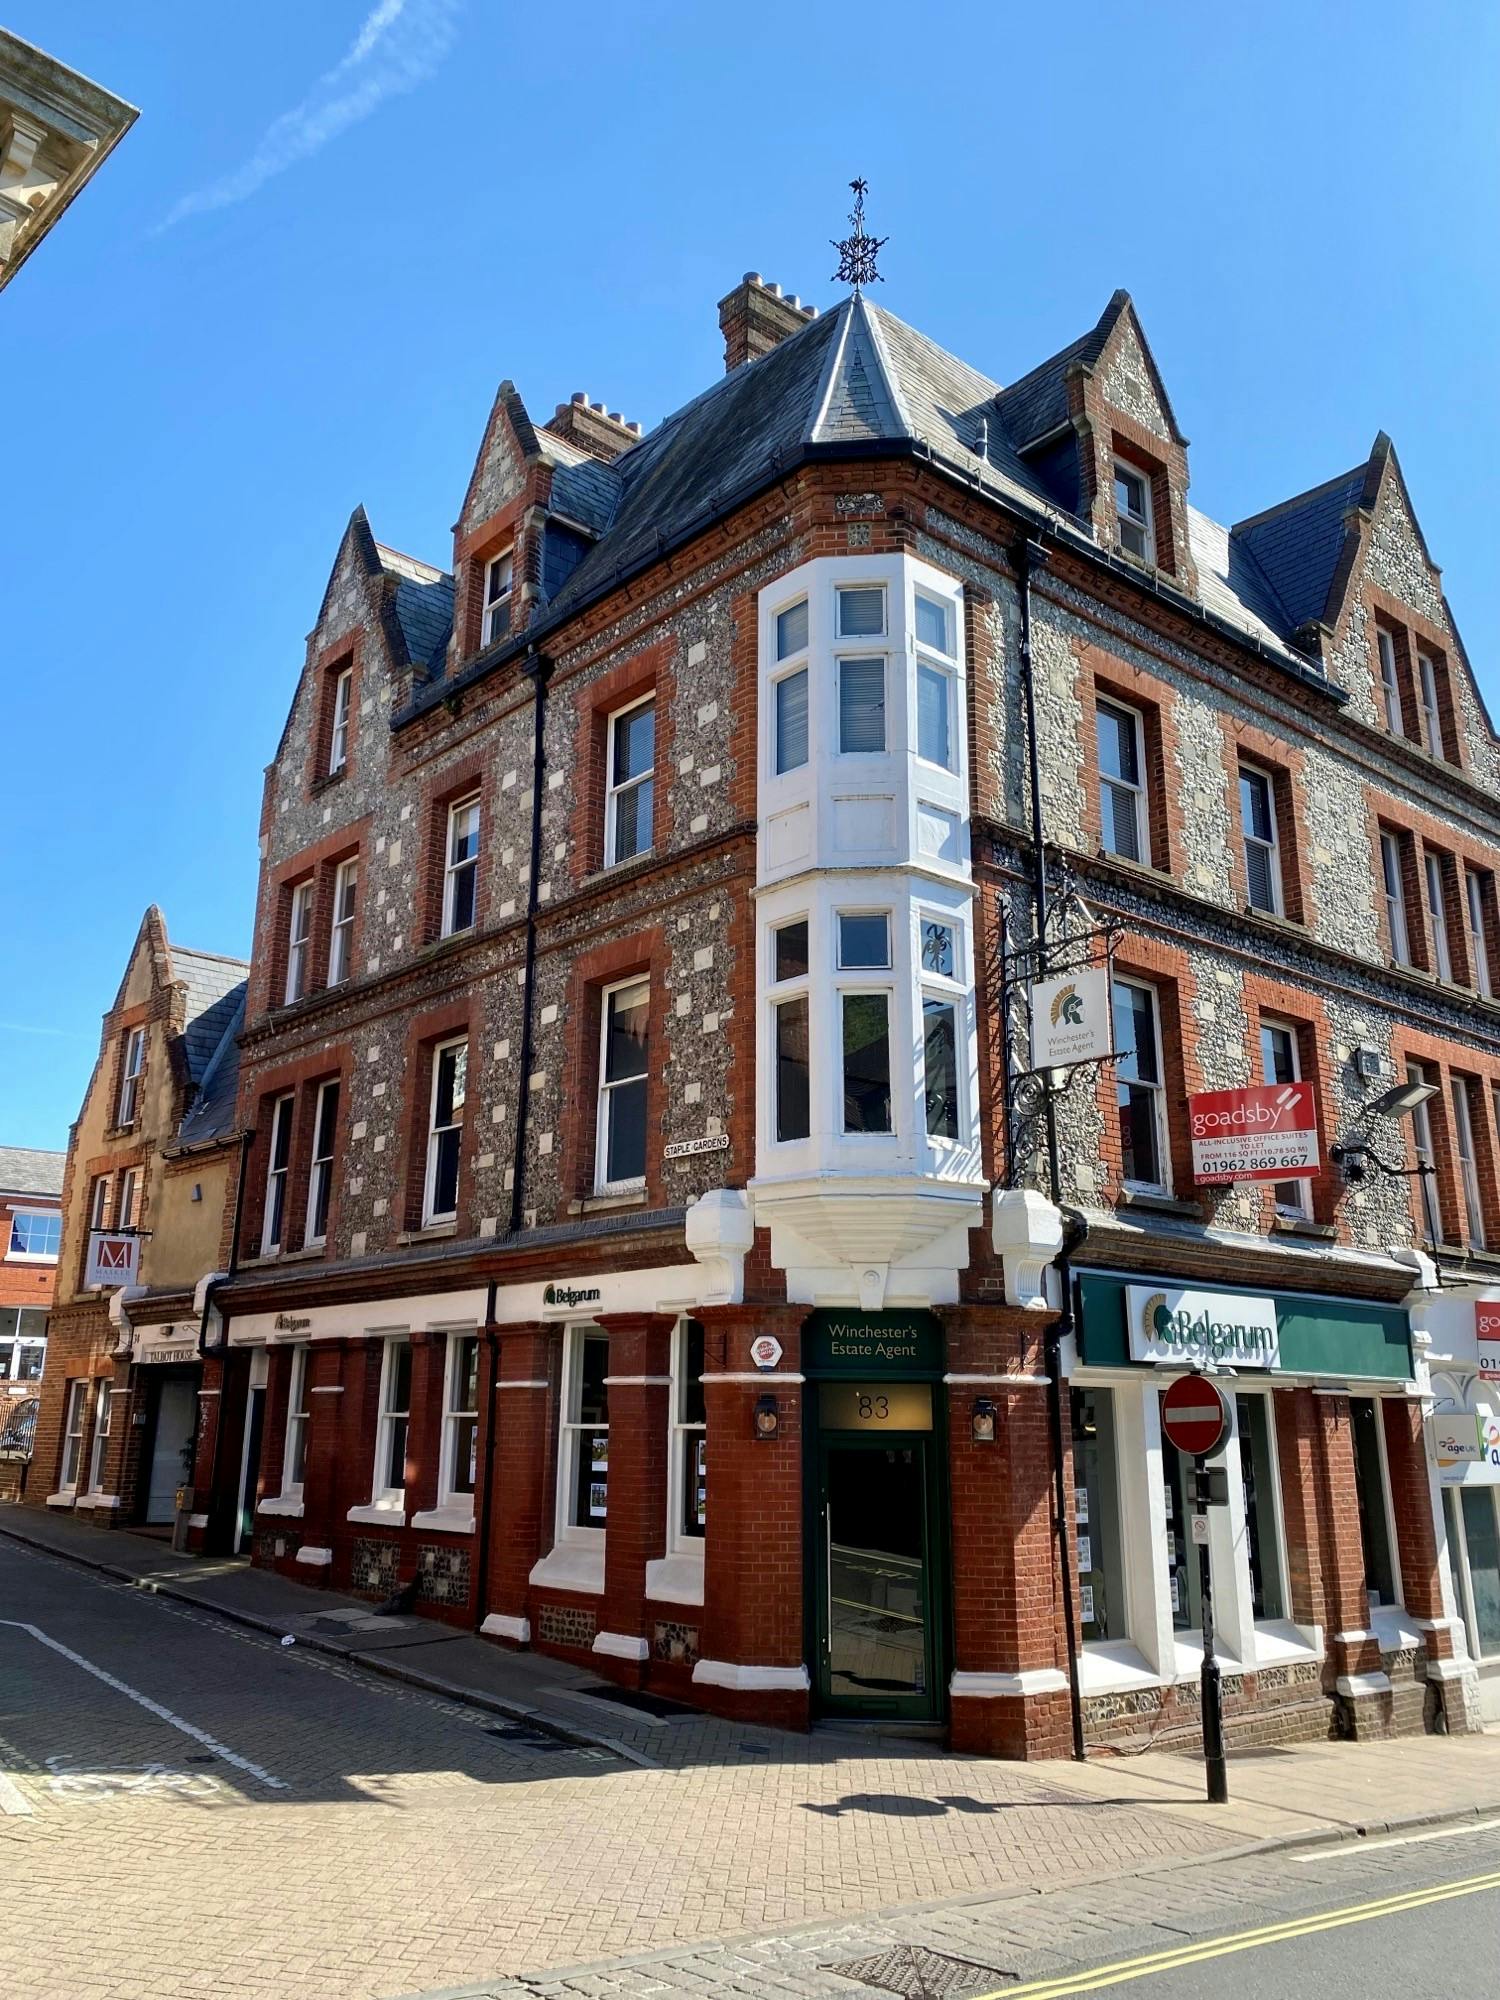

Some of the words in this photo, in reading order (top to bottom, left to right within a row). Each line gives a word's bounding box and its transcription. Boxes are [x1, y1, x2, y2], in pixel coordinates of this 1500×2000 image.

[1047, 1030, 1095, 1046] Winchester's
[1049, 1047, 1071, 1057] Estate
[1072, 1041, 1094, 1053] Agent
[1193, 1102, 1283, 1136] goadsby
[666, 1143, 690, 1156] STAPLE
[693, 1137, 727, 1151] GARDENS
[1198, 1135, 1252, 1147] ALL-INCLUSIVE
[1253, 1133, 1279, 1142] OFFICE
[1281, 1131, 1308, 1140] SUITES
[1200, 1152, 1222, 1160] FROM
[1223, 1150, 1238, 1158] 116
[1238, 1150, 1249, 1158] SQ
[1285, 1147, 1296, 1155] SQ
[1297, 1145, 1308, 1153] M)
[1202, 1159, 1246, 1173] 01962
[1250, 1157, 1277, 1170] 869
[1280, 1155, 1308, 1168] 667
[1200, 1172, 1253, 1184] goadsby.com
[556, 1286, 601, 1308] Belgarum
[828, 1324, 918, 1339] Winchester's
[1178, 1309, 1274, 1359] Belgarum
[831, 1341, 872, 1355] Estate
[875, 1342, 917, 1360] Agent
[858, 1395, 889, 1420] 83
